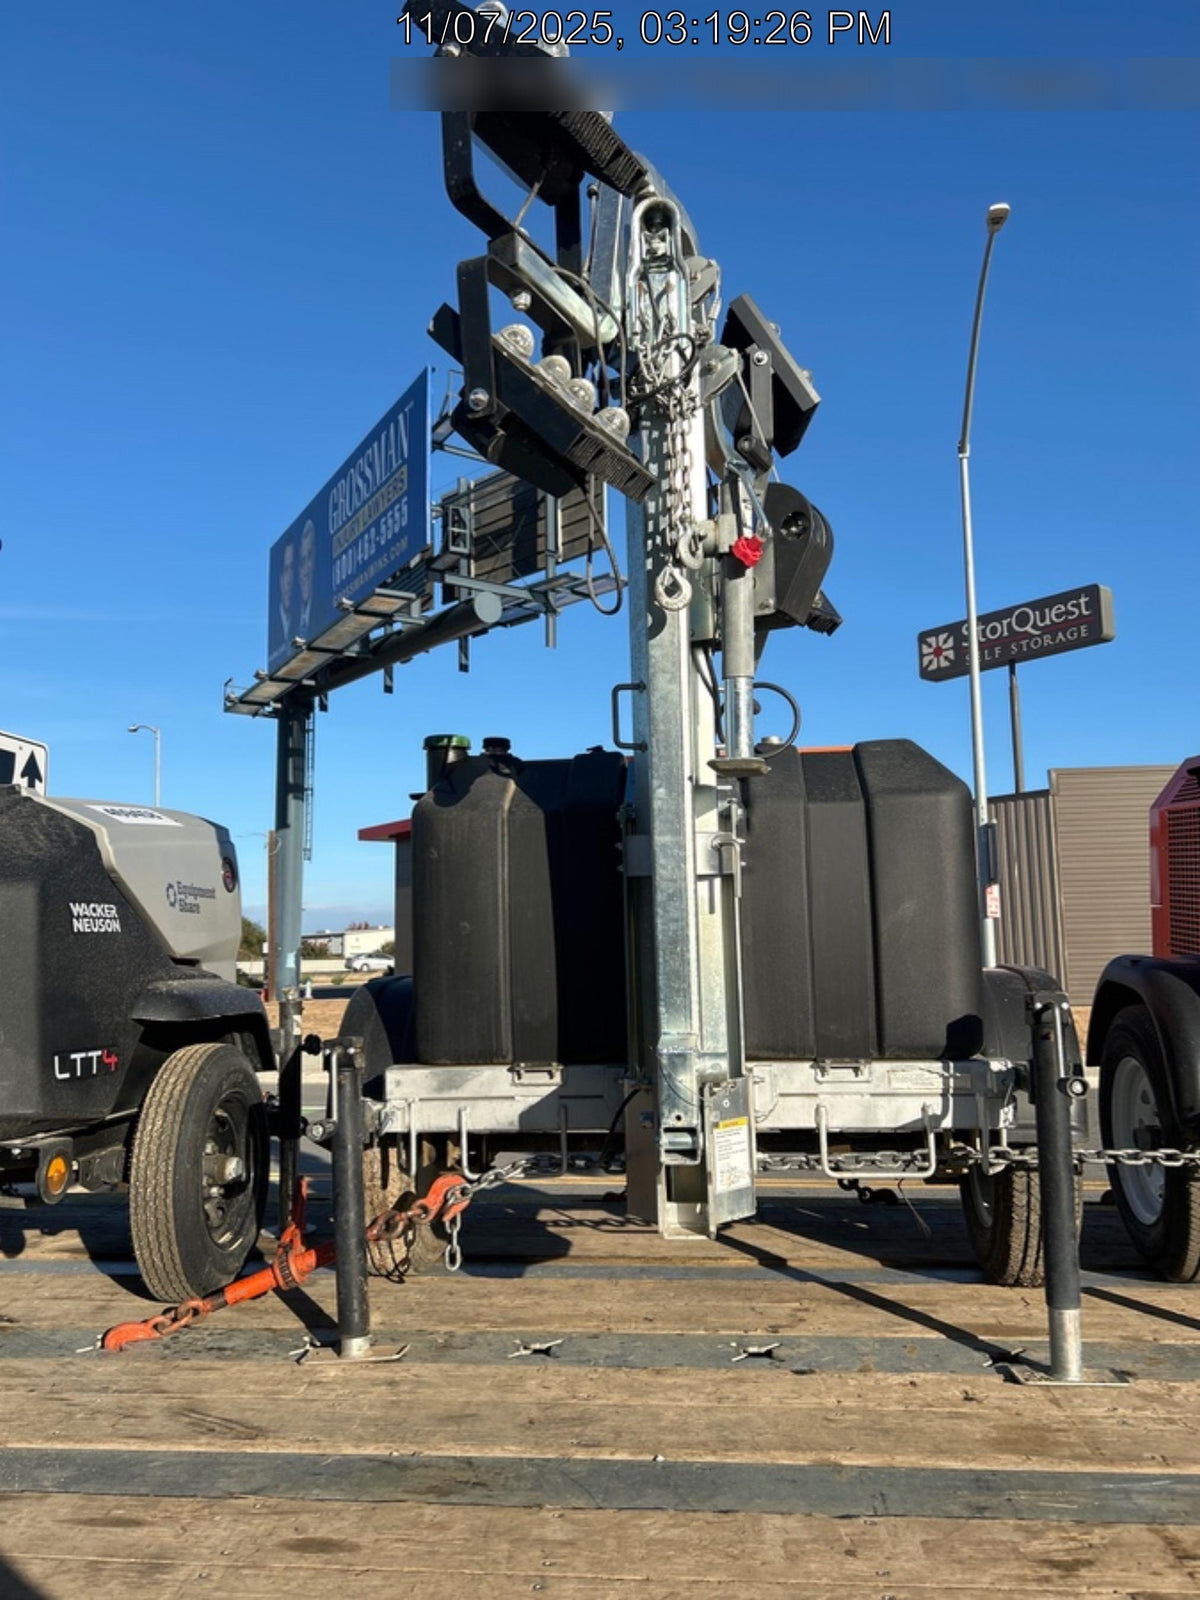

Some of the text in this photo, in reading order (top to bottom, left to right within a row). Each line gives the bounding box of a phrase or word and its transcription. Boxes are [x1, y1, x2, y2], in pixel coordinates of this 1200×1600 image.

[328, 400, 414, 534] GROSSMAN
[367, 469, 406, 528] LAWYERS
[1010, 624, 1089, 656] STORAGE
[176, 880, 216, 900] Equipment
[69, 902, 118, 918] WACKER
[179, 898, 200, 914] Share
[72, 917, 121, 933] NEUSON
[54, 1048, 118, 1080] LTT4
